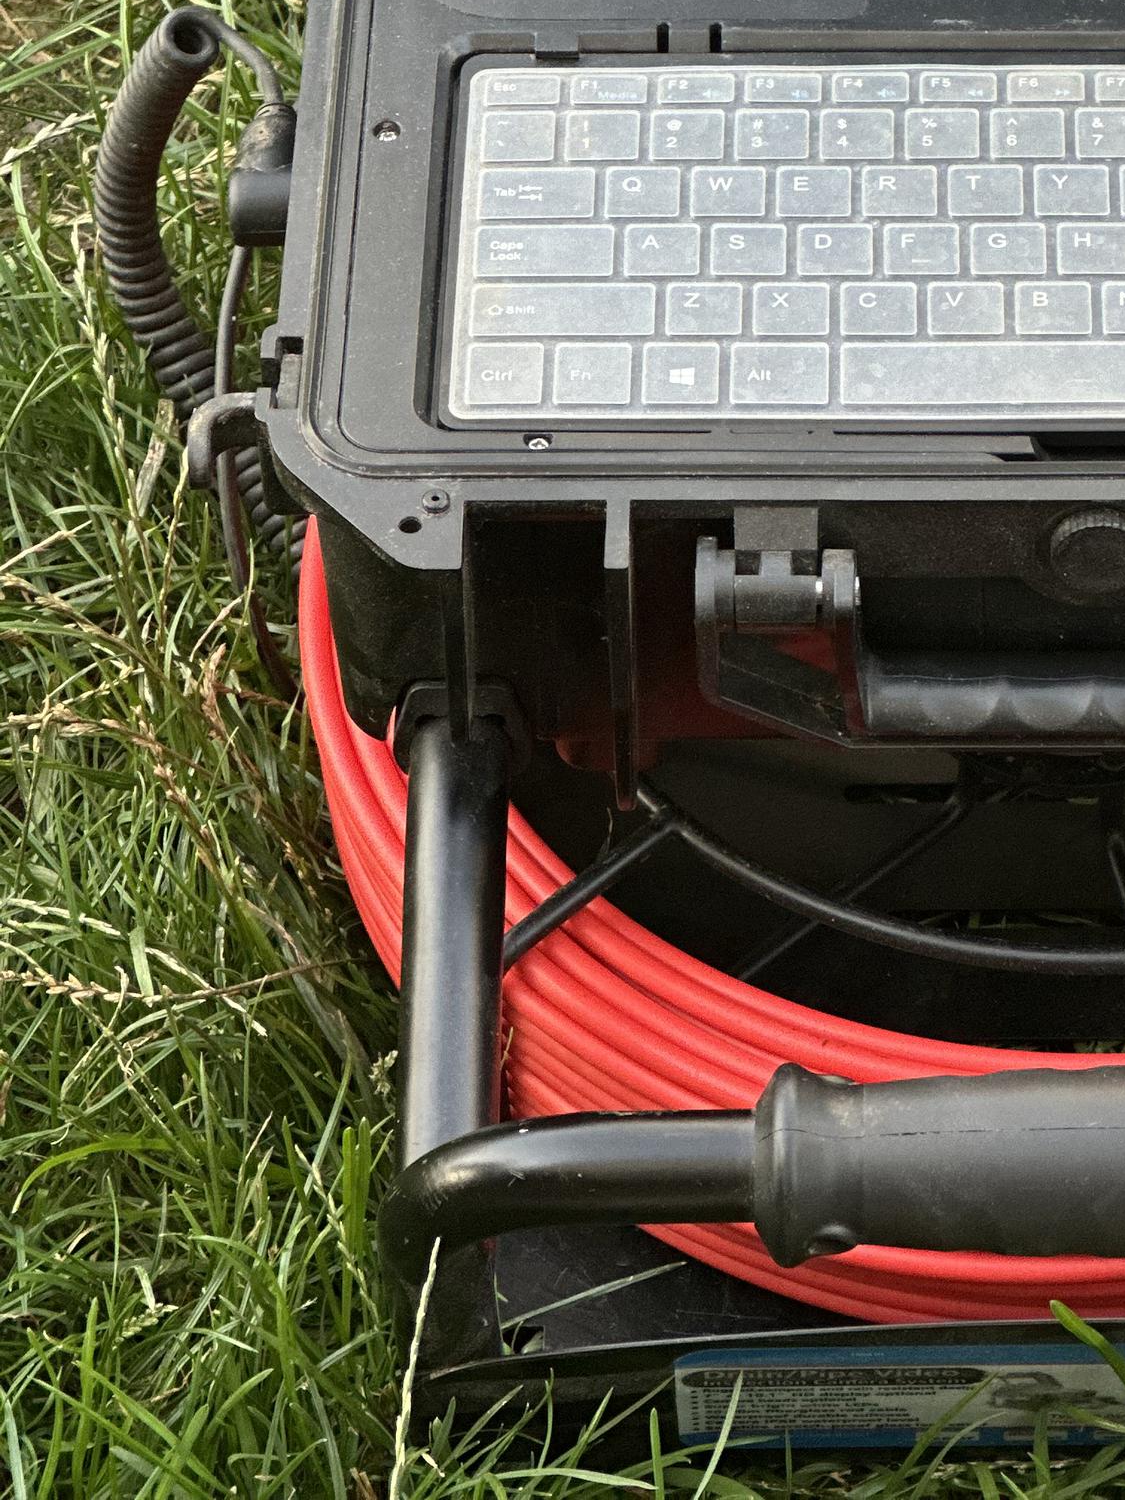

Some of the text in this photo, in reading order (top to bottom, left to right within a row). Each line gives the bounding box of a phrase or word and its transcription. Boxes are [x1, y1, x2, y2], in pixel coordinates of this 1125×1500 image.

[668, 80, 688, 90] F2
[755, 79, 775, 89] F3
[843, 78, 864, 88] F4
[931, 78, 951, 88] F5
[1018, 77, 1039, 88] F6
[1106, 77, 1125, 87] F7
[666, 137, 679, 148] 2
[751, 136, 763, 149] 3
[836, 135, 849, 147] 4
[922, 135, 933, 148] 5
[1006, 134, 1018, 147] 6
[1092, 134, 1104, 146] 7
[622, 176, 642, 193] Q
[709, 177, 733, 191] W
[794, 177, 810, 191] E
[878, 176, 896, 190] R
[966, 176, 981, 190] T
[1052, 175, 1069, 189] Y
[493, 186, 517, 197] Tab
[641, 235, 660, 249] A
[728, 234, 745, 249] S
[814, 234, 832, 249] D
[901, 234, 916, 248] F
[988, 233, 1007, 248] G
[1074, 232, 1091, 247] H
[684, 293, 700, 307] Z
[772, 293, 789, 307] X
[859, 293, 877, 307] C
[945, 292, 963, 306] V
[1033, 292, 1049, 306] B
[481, 369, 513, 382] Ctrl
[570, 370, 592, 381] Fn
[747, 369, 772, 381] Alt
